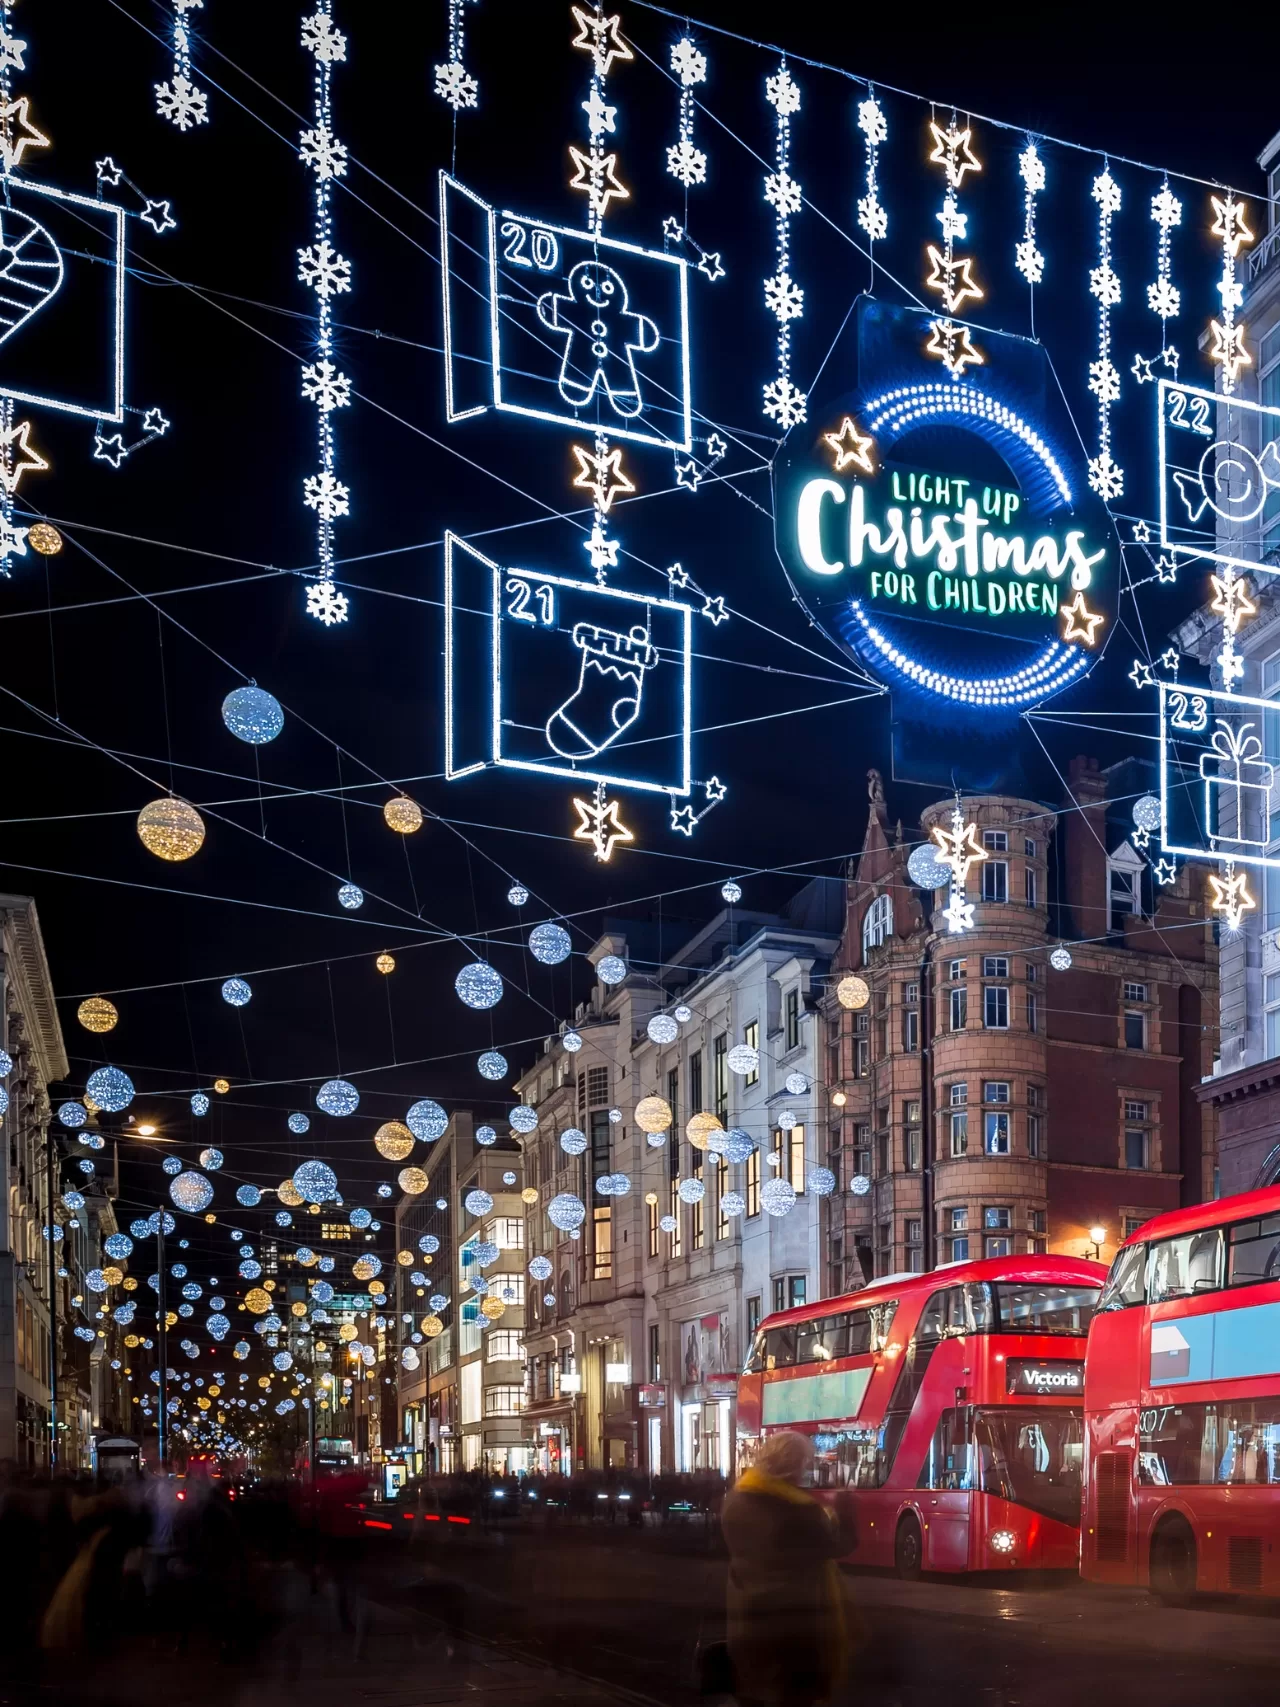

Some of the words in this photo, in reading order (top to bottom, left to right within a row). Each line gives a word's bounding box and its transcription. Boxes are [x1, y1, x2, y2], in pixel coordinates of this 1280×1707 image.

[501, 221, 558, 270] 20
[1167, 390, 1213, 435] 22
[892, 471, 970, 508] LIGHT
[982, 486, 1020, 524] UP
[798, 478, 1106, 590] Christmas
[506, 578, 554, 625] 21
[870, 570, 918, 605] FOR
[926, 570, 1060, 617] CHILDREN
[1168, 692, 1208, 731] 23
[1024, 1369, 1078, 1387] Victoria
